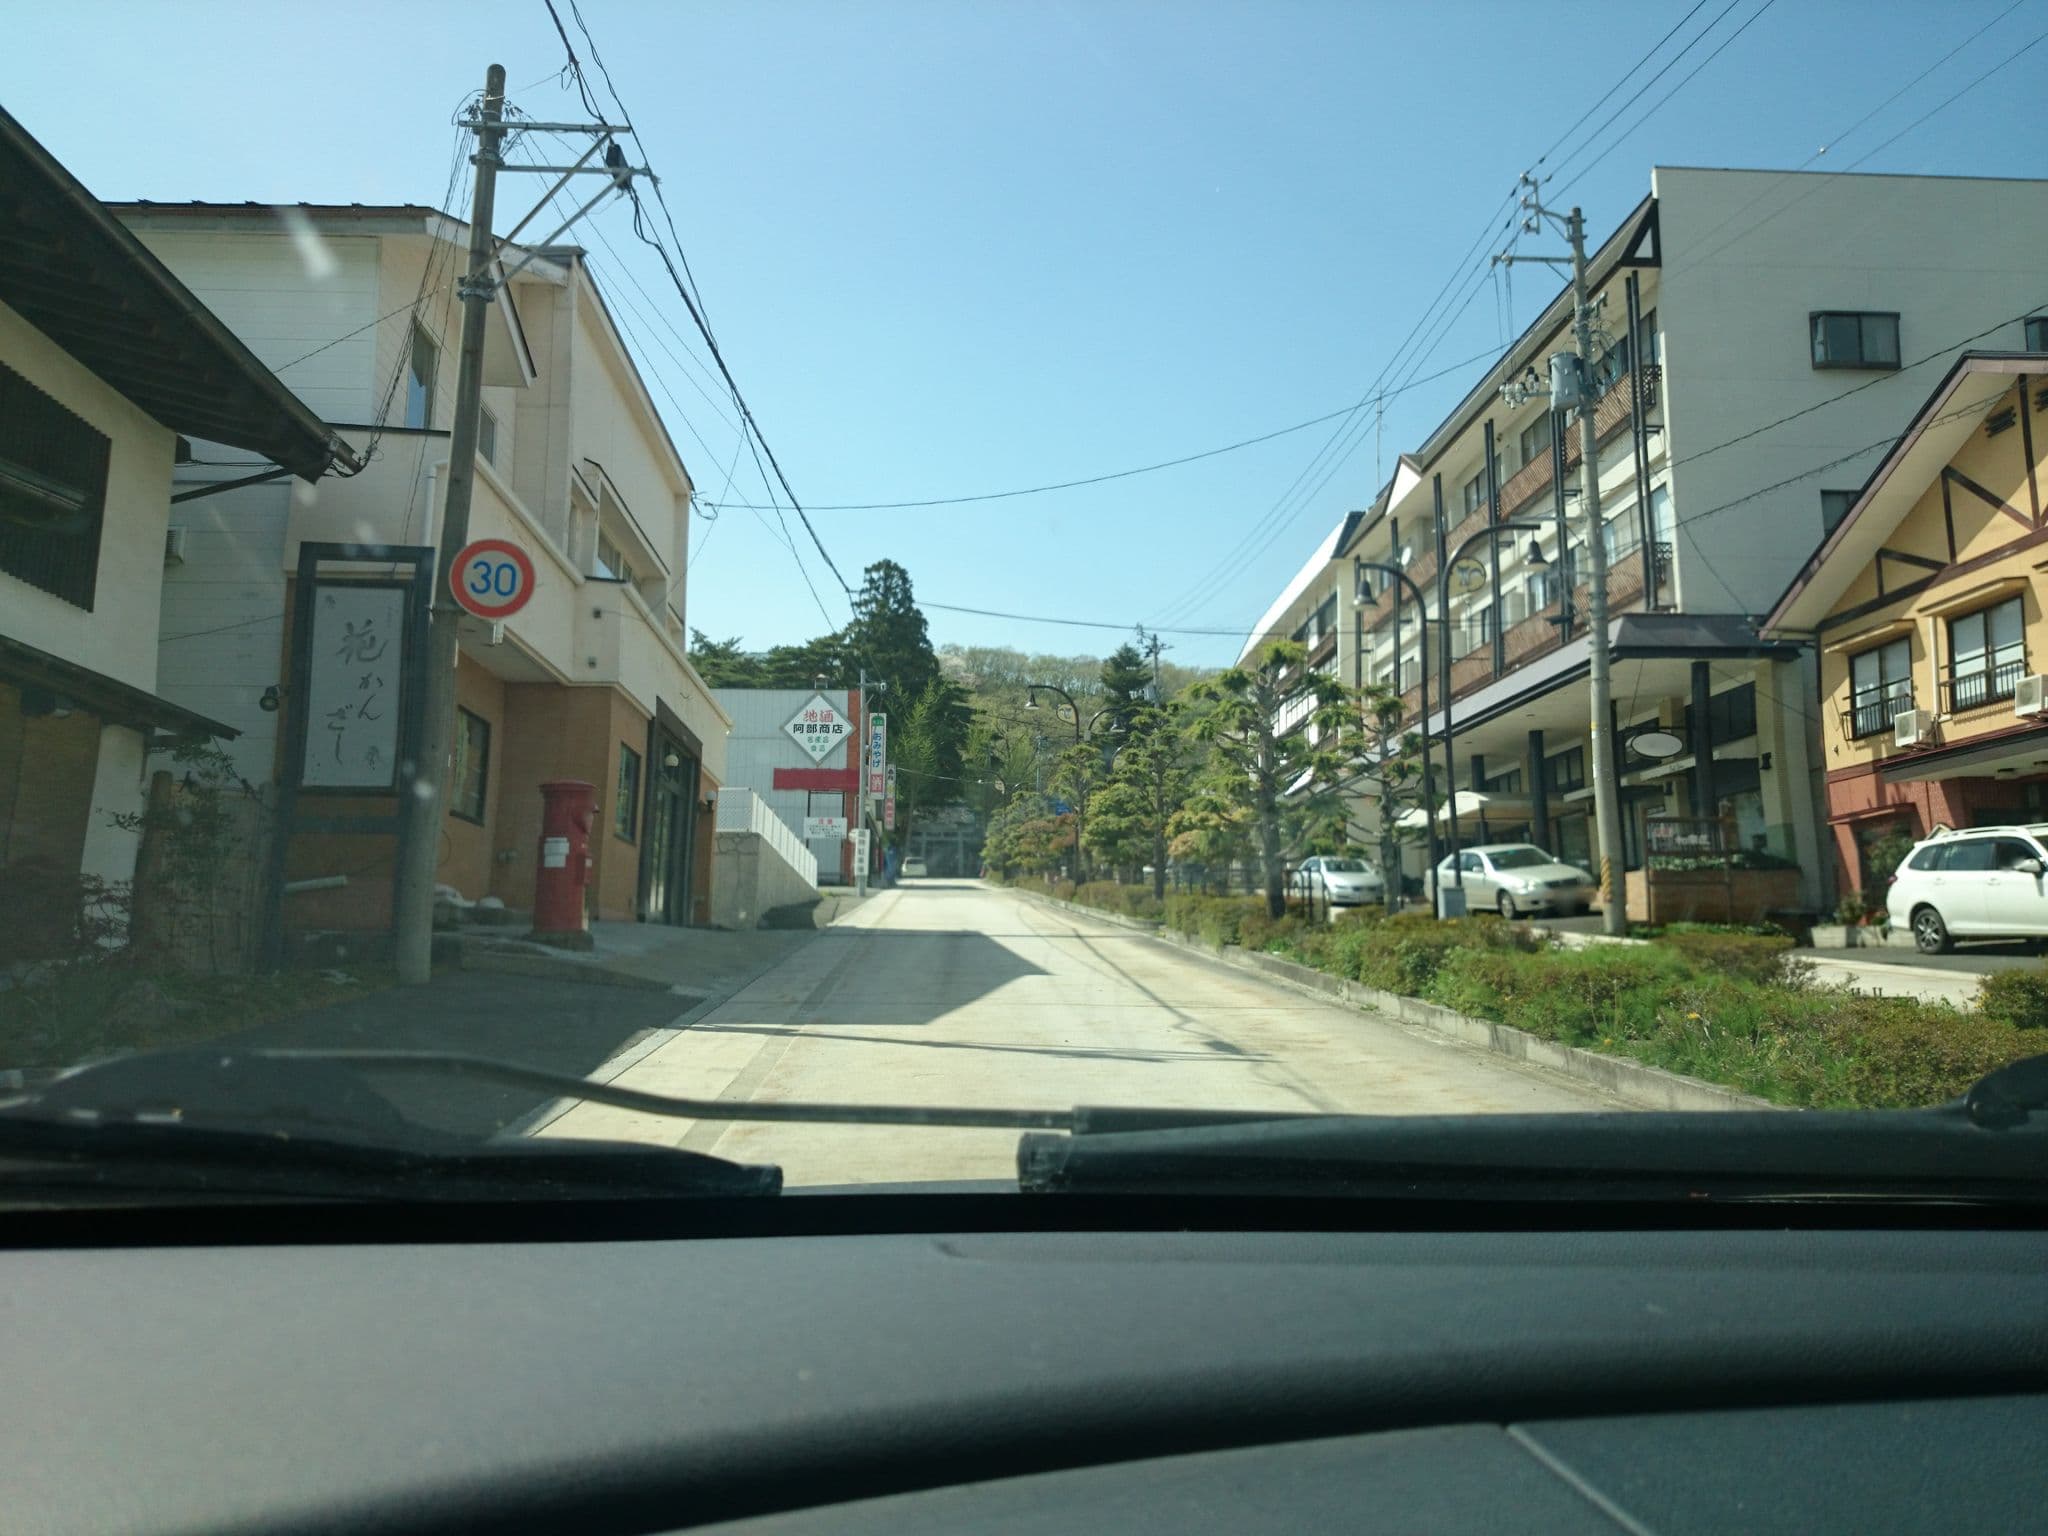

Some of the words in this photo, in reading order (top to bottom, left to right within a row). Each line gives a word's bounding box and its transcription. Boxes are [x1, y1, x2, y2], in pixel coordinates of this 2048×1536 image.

[470, 560, 516, 596] 30
[803, 708, 834, 723] 地酒
[793, 723, 843, 734] 阿部商店
[872, 733, 882, 768] おみやげ
